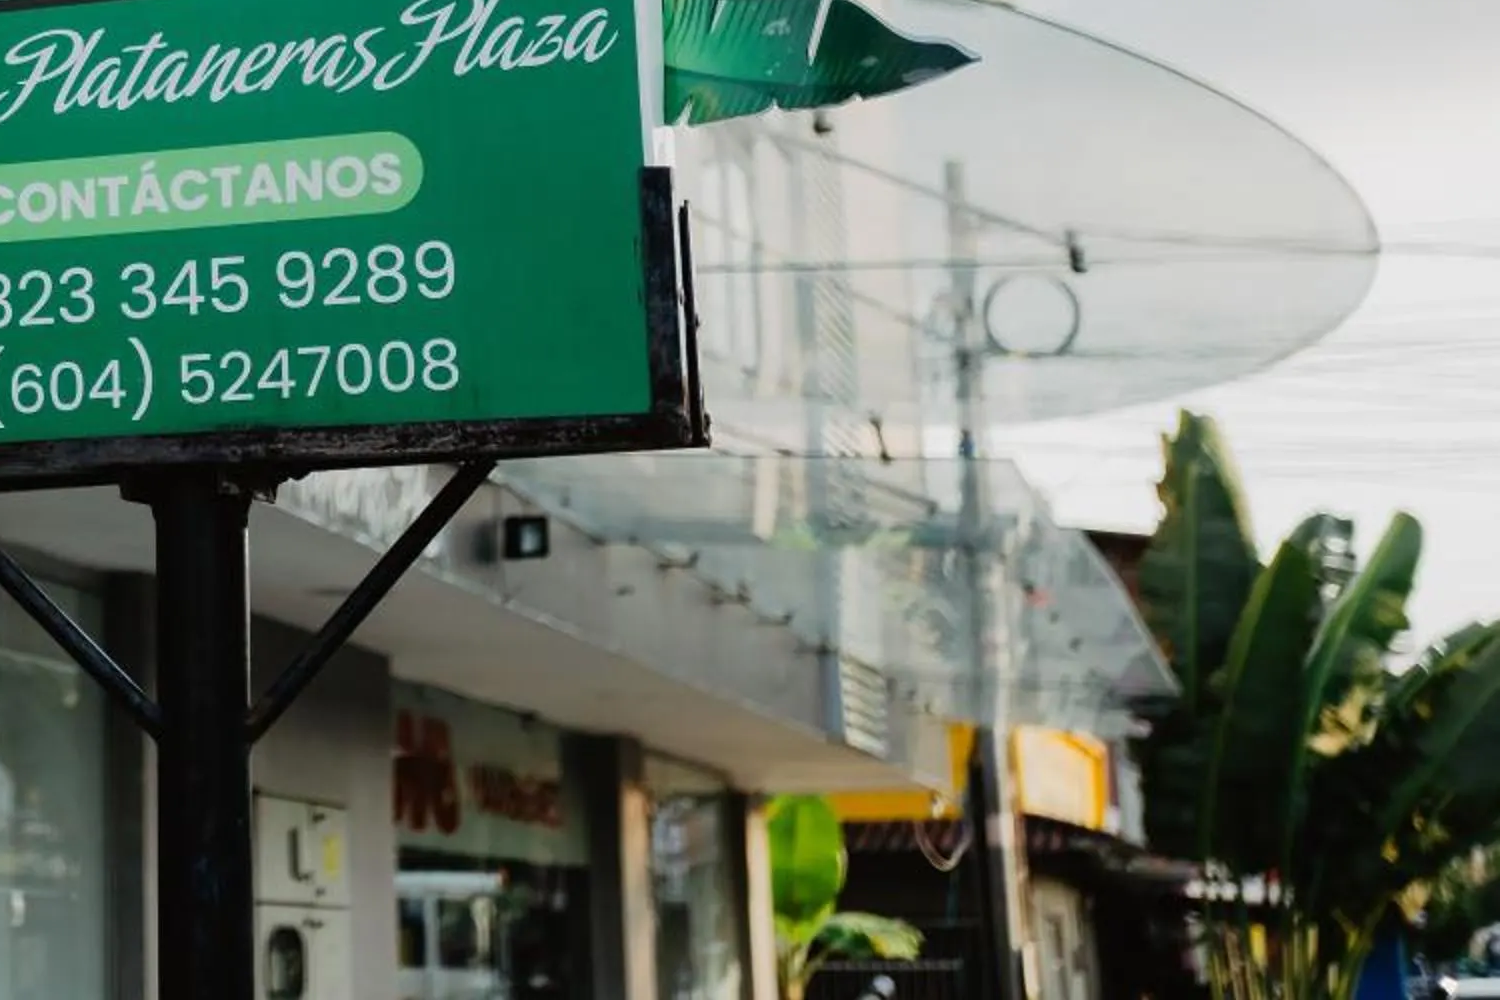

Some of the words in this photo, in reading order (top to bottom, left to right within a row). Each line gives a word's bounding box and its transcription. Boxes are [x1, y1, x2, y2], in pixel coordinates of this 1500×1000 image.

[120, 255, 249, 319] 345
[276, 240, 456, 309] 9289
[180, 338, 460, 404] 5247008
